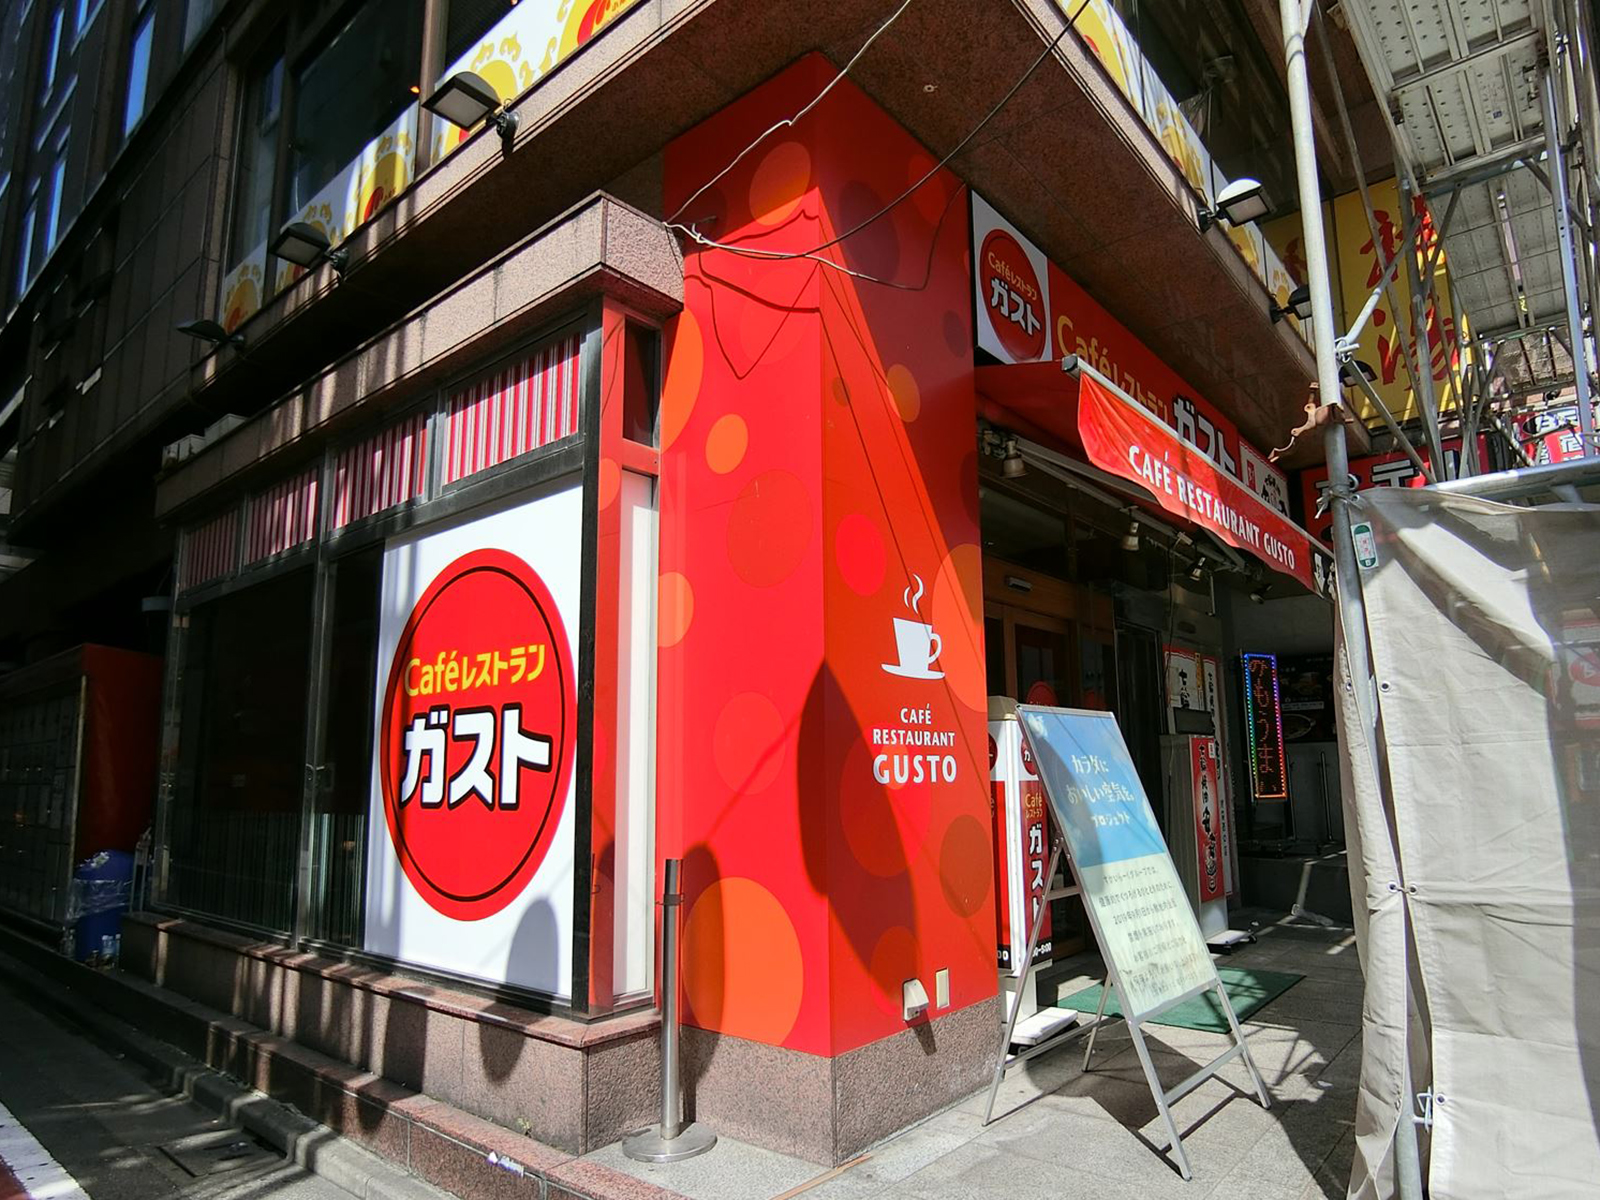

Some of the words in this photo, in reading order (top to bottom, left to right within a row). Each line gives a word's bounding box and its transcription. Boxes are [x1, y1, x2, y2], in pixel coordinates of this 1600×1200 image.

[988, 252, 1037, 300] Caféレストラン
[991, 278, 1041, 336] ガスト
[1174, 396, 1238, 477] ガスト
[1128, 446, 1172, 495] CAFÉ
[1177, 473, 1260, 549] RESTAURANT
[1263, 532, 1295, 570] GUSTO
[404, 644, 546, 696] Caféレストラン
[873, 729, 955, 747] RESTAURANT
[900, 703, 931, 725] CAFÉ
[400, 706, 550, 806] ガスト
[873, 754, 957, 784] GUSTO
